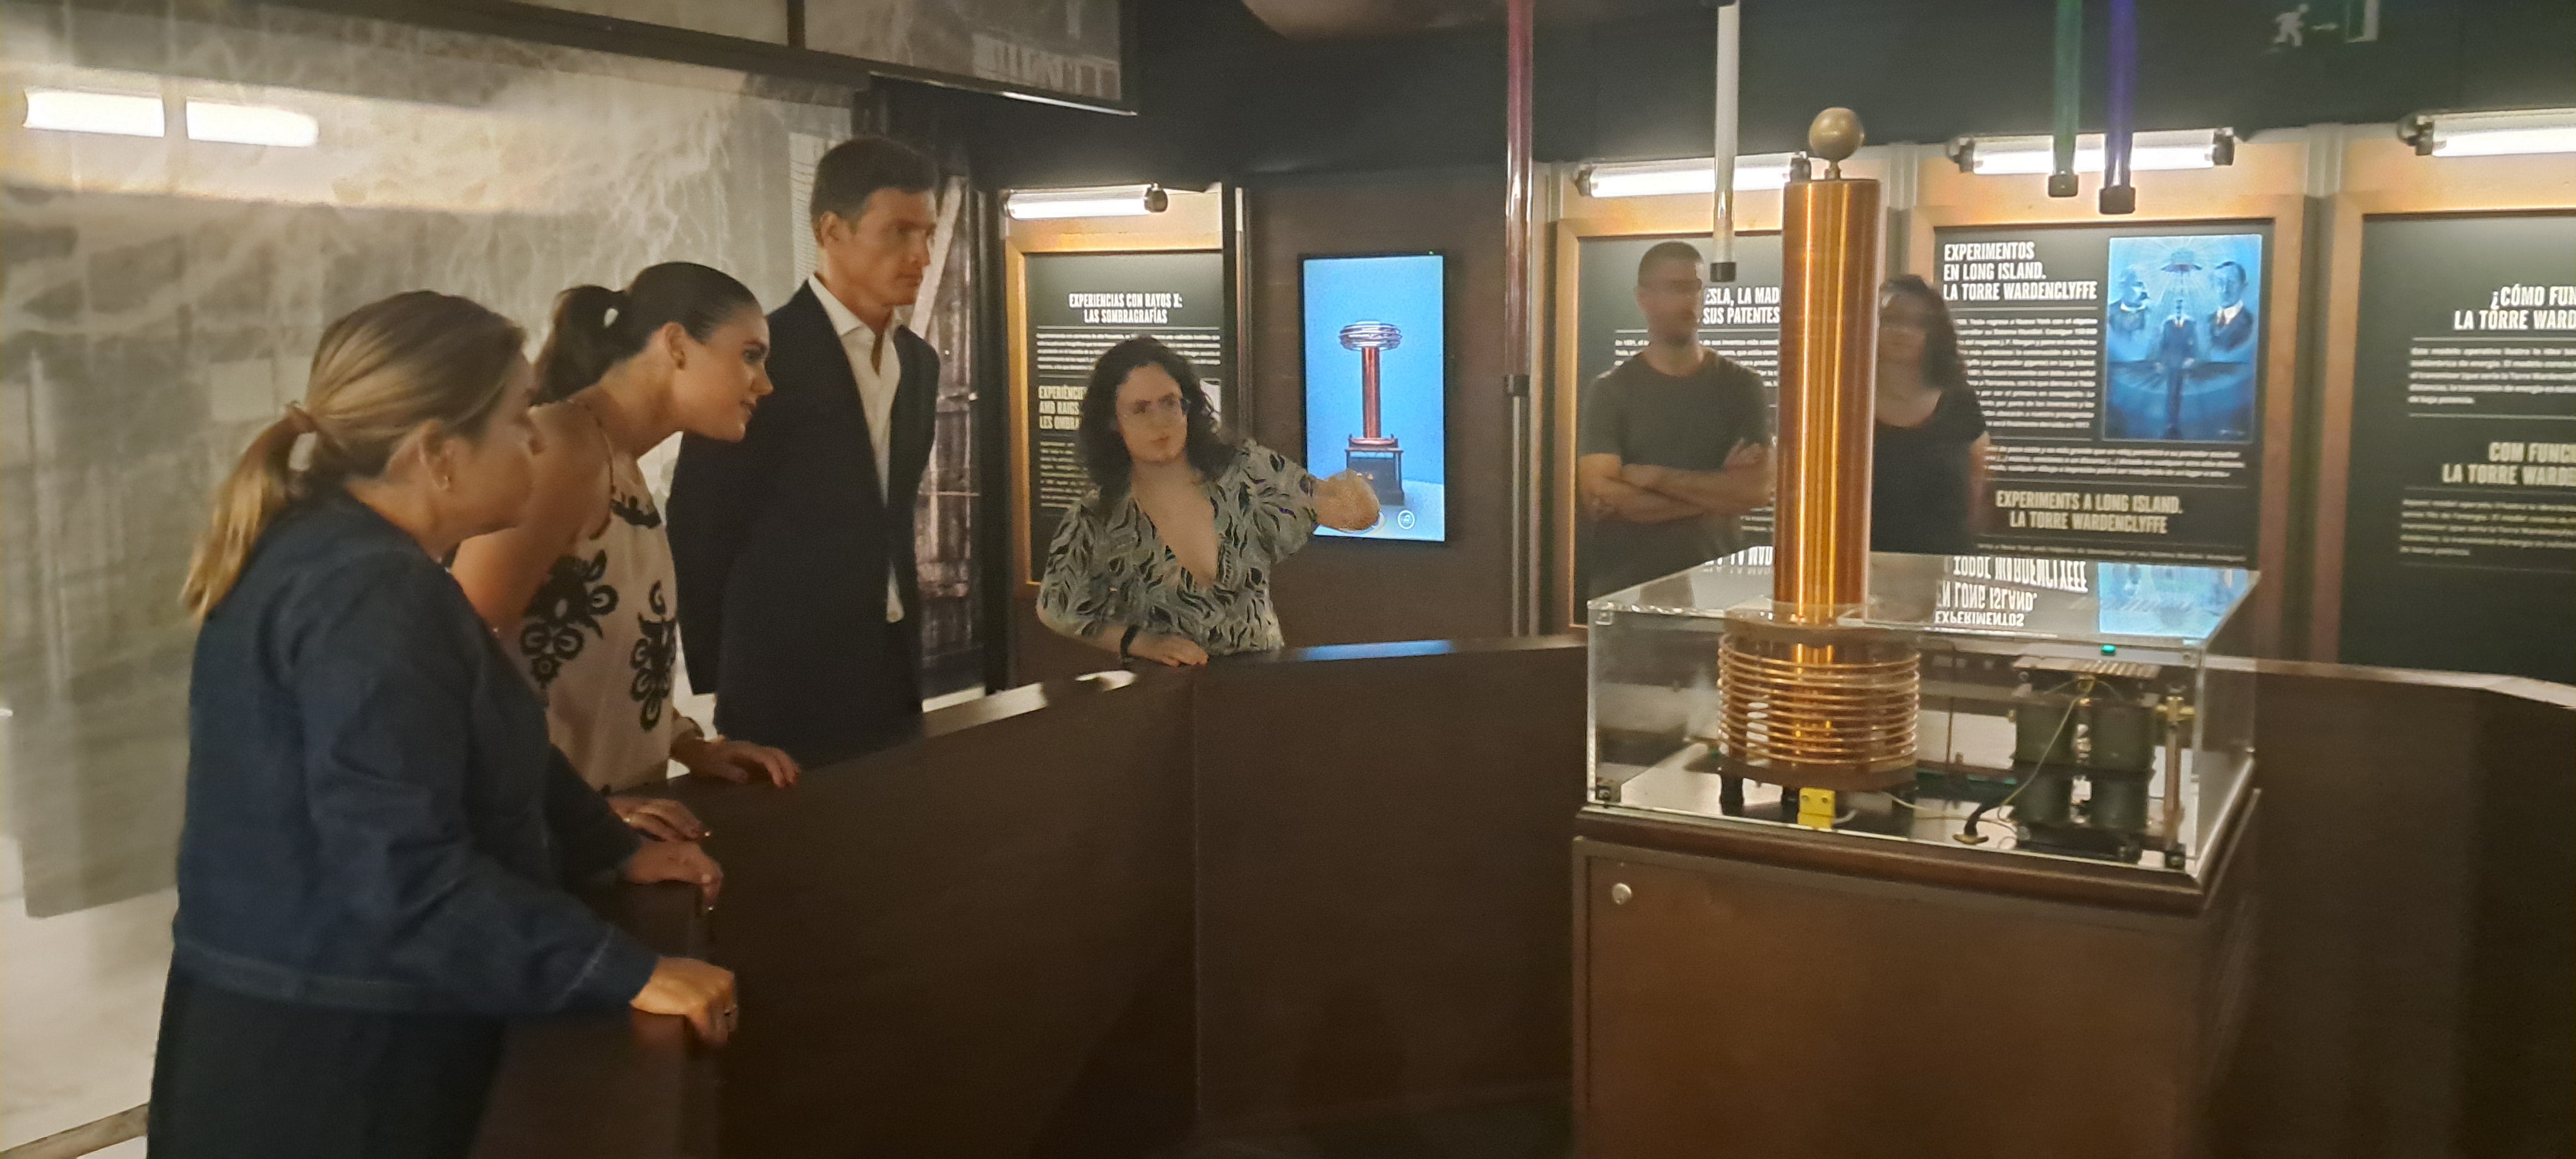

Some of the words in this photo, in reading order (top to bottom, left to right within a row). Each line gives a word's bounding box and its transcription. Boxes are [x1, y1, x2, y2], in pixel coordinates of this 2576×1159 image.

[1944, 242, 2035, 261] EXPERIMENTOS
[1943, 264, 1959, 281] EN
[1963, 263, 1995, 280] LONG
[1998, 261, 2047, 280] ISLAND.
[1068, 293, 1124, 308] EXPERIENCIAS
[1126, 293, 1143, 308] CON
[1145, 293, 1172, 309] RAYOS
[1737, 287, 1752, 304] LA
[1755, 287, 1780, 304] MAD
[1943, 283, 1959, 301] LA
[1961, 283, 2000, 301] TORRE
[2003, 281, 2098, 300] WARDENCLYFFE
[2491, 283, 2545, 309] ¿CÓMO
[1083, 309, 1100, 324] LAS
[1101, 306, 1168, 324] SOMBRAGRAFÍAS
[1702, 307, 1724, 324] SUS
[1727, 306, 1780, 324] PATENTES
[2454, 309, 2474, 330] LA
[2479, 309, 2529, 330] TORRE
[2488, 442, 2524, 462] COM
[2442, 463, 2462, 483] LA
[2467, 464, 2518, 485] TORRE
[1996, 490, 2080, 510] EXPERIMENTS
[2083, 493, 2092, 510] A
[2094, 494, 2128, 511] LONG
[2132, 494, 2183, 514] ISLAND.
[2009, 510, 2026, 528] LA
[2029, 511, 2069, 529] TORRE
[2072, 512, 2168, 534] WARDENCLYFFE
